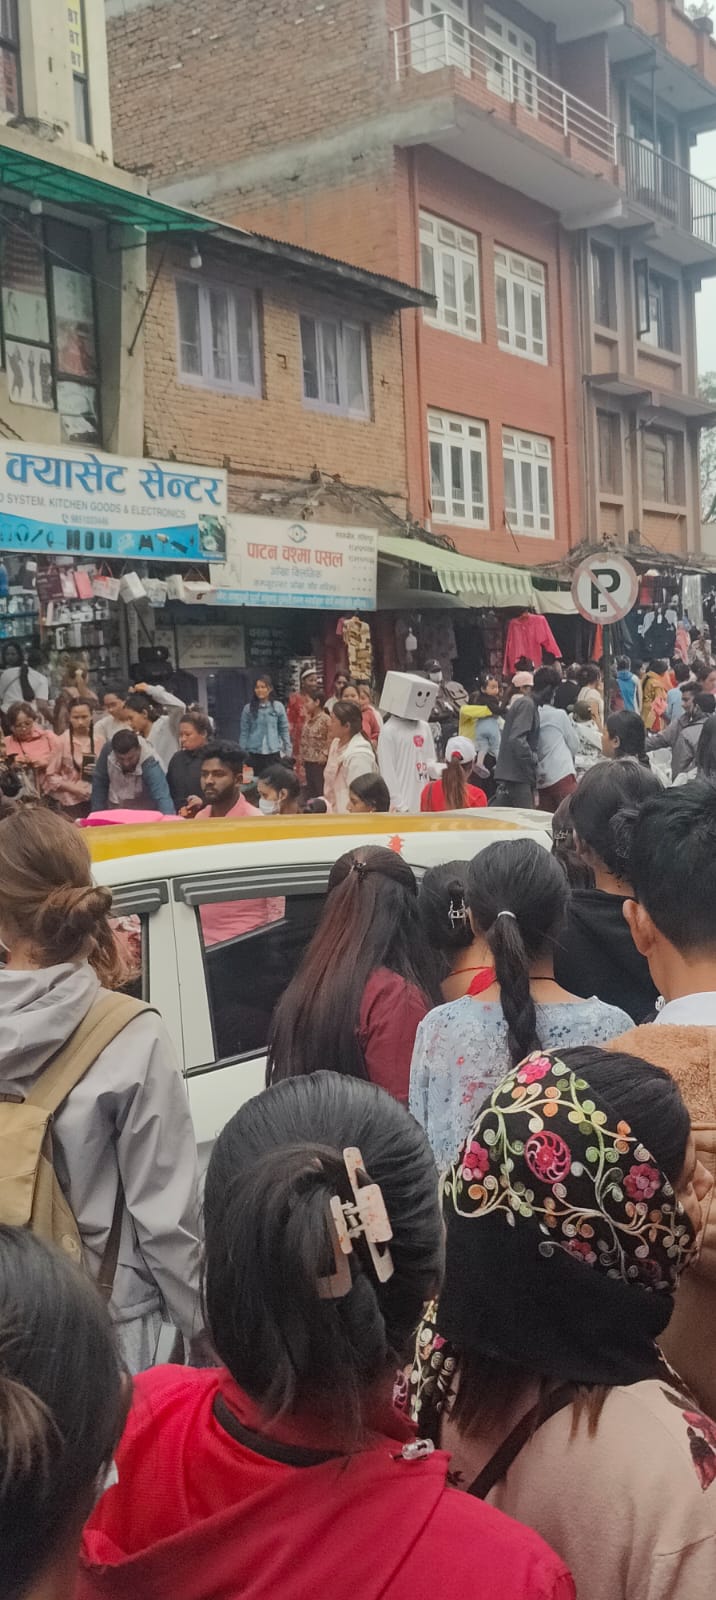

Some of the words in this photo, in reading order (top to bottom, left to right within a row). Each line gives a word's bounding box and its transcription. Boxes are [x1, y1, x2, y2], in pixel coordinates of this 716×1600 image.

[5, 452, 128, 494] क्यासेट
[138, 462, 223, 505] सेन्टर
[49, 498, 88, 510] KITCHEN
[90, 502, 121, 513] GOODS
[124, 505, 128, 513] &
[131, 505, 186, 518] ELECTRONICS
[247, 542, 278, 561] पाटन
[282, 545, 311, 565] चश्मा
[314, 549, 343, 568] पसल
[591, 569, 620, 609] P
